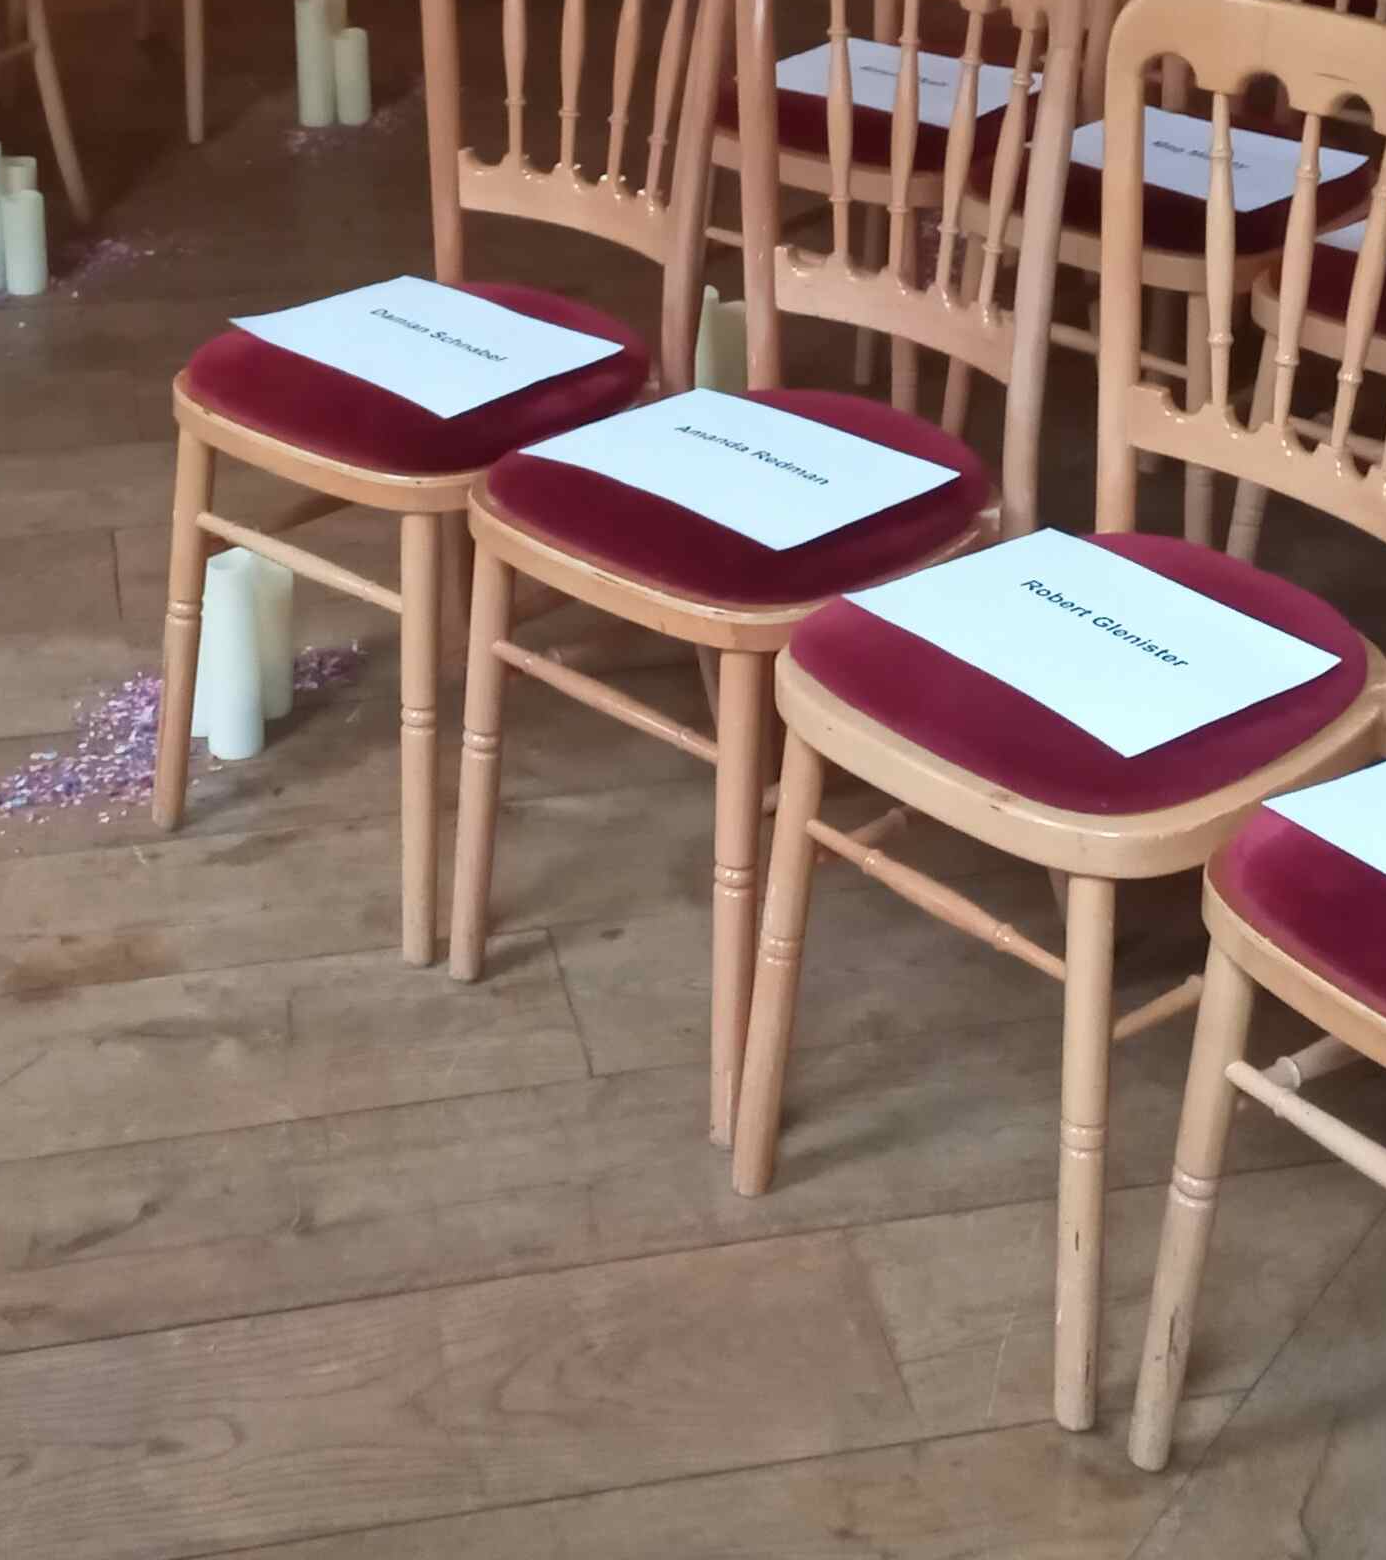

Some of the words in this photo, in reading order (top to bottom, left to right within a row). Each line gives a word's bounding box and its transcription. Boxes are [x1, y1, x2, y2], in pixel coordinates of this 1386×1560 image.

[370, 307, 430, 334] Damian
[430, 330, 508, 362] Schnabel
[673, 425, 749, 453] Amanda
[749, 449, 829, 486] Redman
[1020, 578, 1093, 618] Robert
[1091, 615, 1190, 667] Glenister
